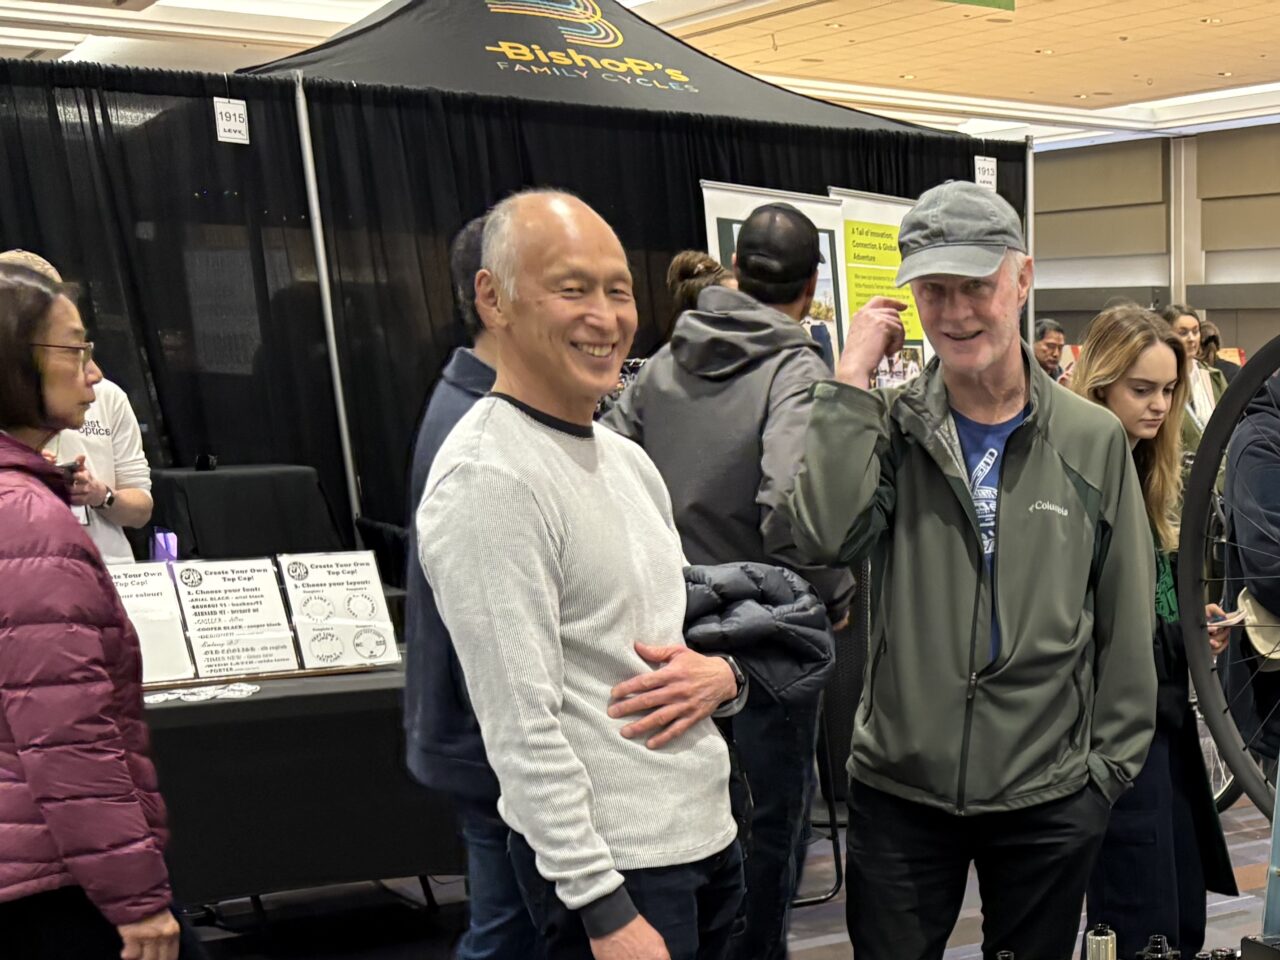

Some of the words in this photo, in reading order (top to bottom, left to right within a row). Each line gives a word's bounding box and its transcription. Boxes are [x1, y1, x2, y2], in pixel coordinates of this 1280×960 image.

[496, 61, 588, 79] FAMILY
[601, 73, 700, 93] CYCLES
[219, 111, 245, 124] 1915
[977, 166, 996, 177] 1913
